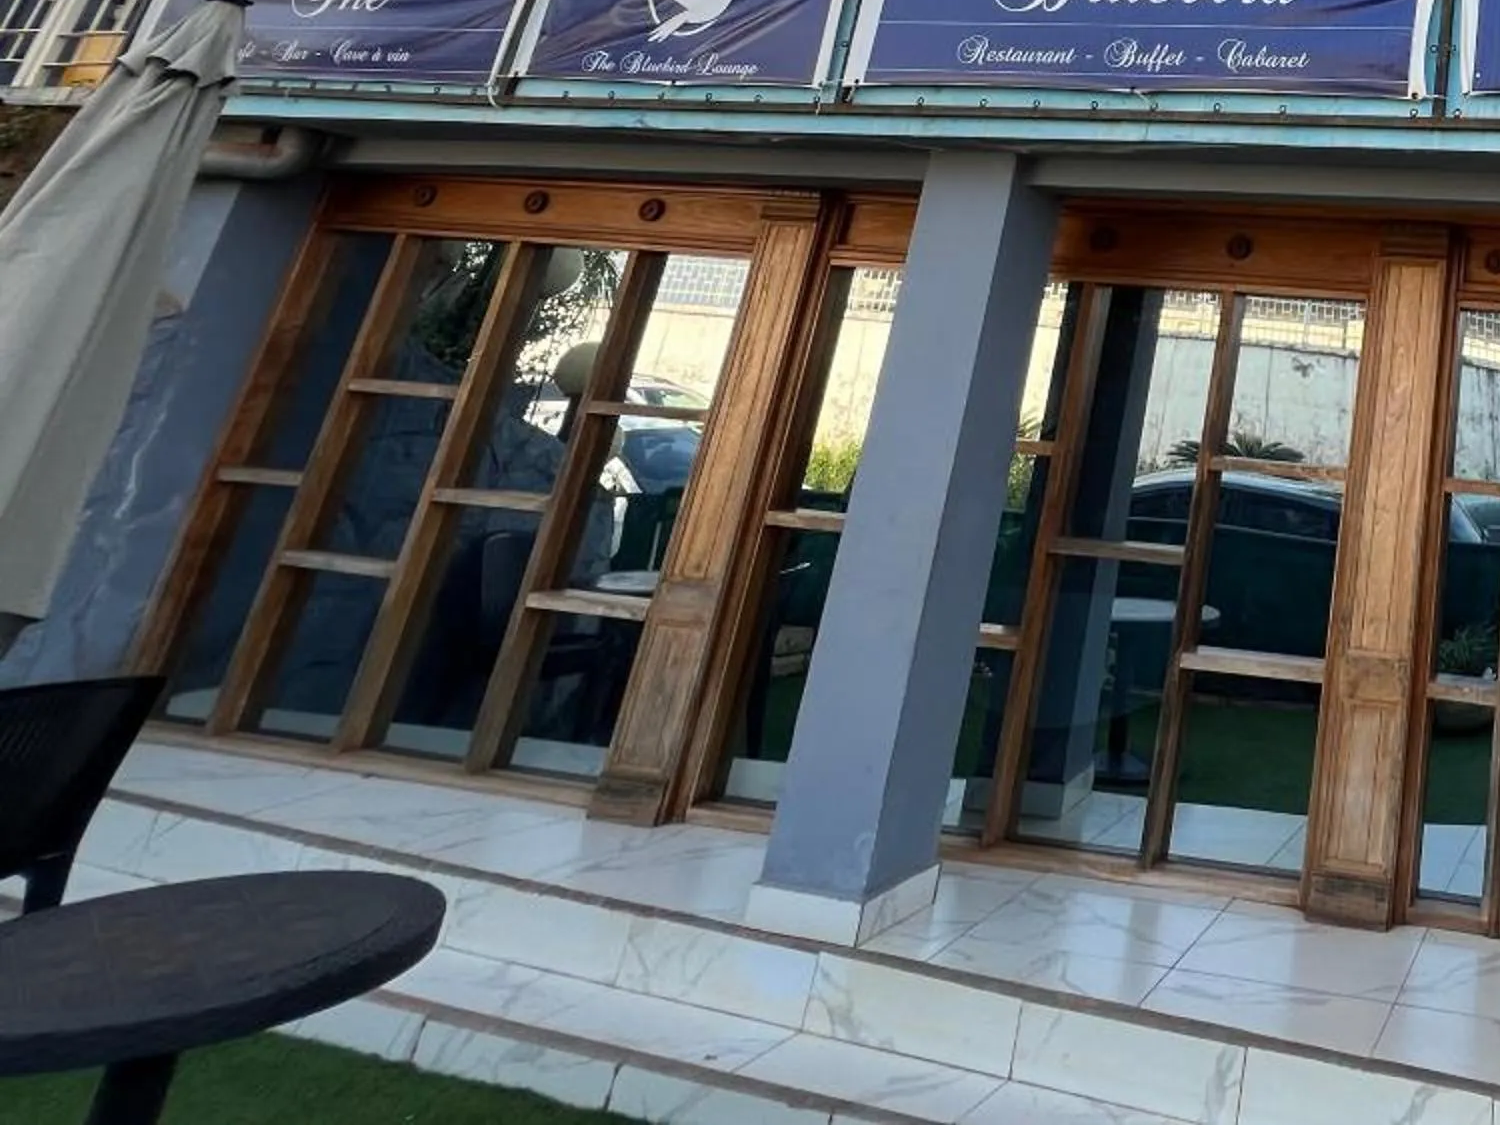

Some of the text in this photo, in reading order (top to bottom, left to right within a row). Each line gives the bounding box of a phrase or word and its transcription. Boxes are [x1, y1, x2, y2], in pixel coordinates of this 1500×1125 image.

[273, 40, 308, 62] Bar
[330, 37, 367, 66] Cave
[387, 48, 411, 62] vin
[582, 50, 760, 81] The Bluebird Lounge
[957, 35, 1078, 65] Restaurant
[1104, 40, 1187, 73] Buffet
[1217, 38, 1310, 69] Cabaret
